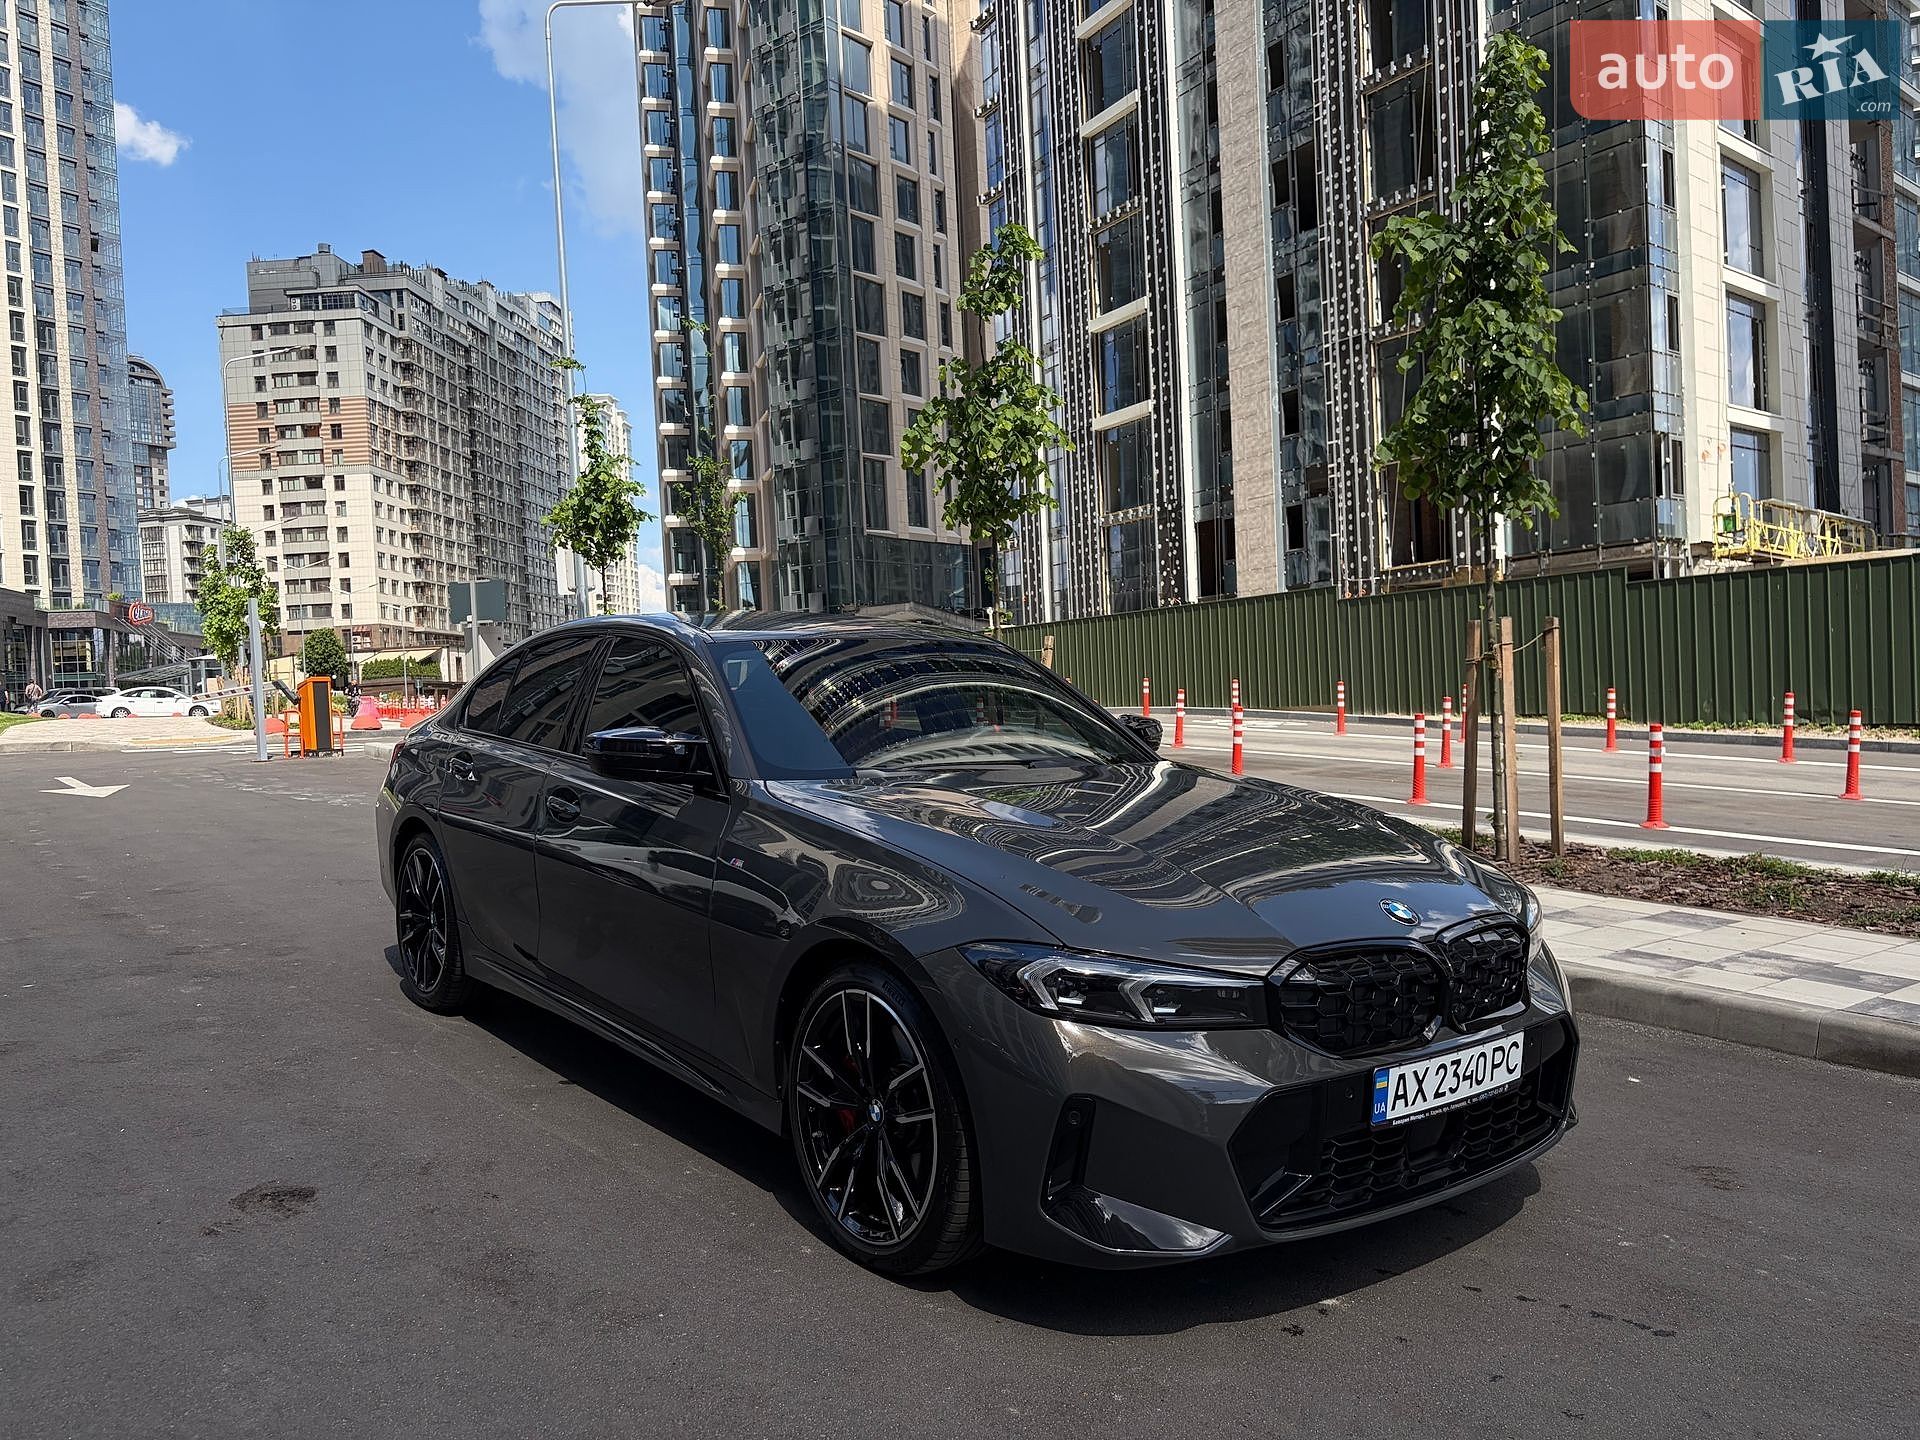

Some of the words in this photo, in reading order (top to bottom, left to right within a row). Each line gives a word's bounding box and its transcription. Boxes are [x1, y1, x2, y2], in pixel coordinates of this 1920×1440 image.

[1390, 1066, 1430, 1112] AX
[1432, 1051, 1488, 1100] 2340
[1490, 1040, 1520, 1082] PC
[1374, 1101, 1386, 1114] UA
